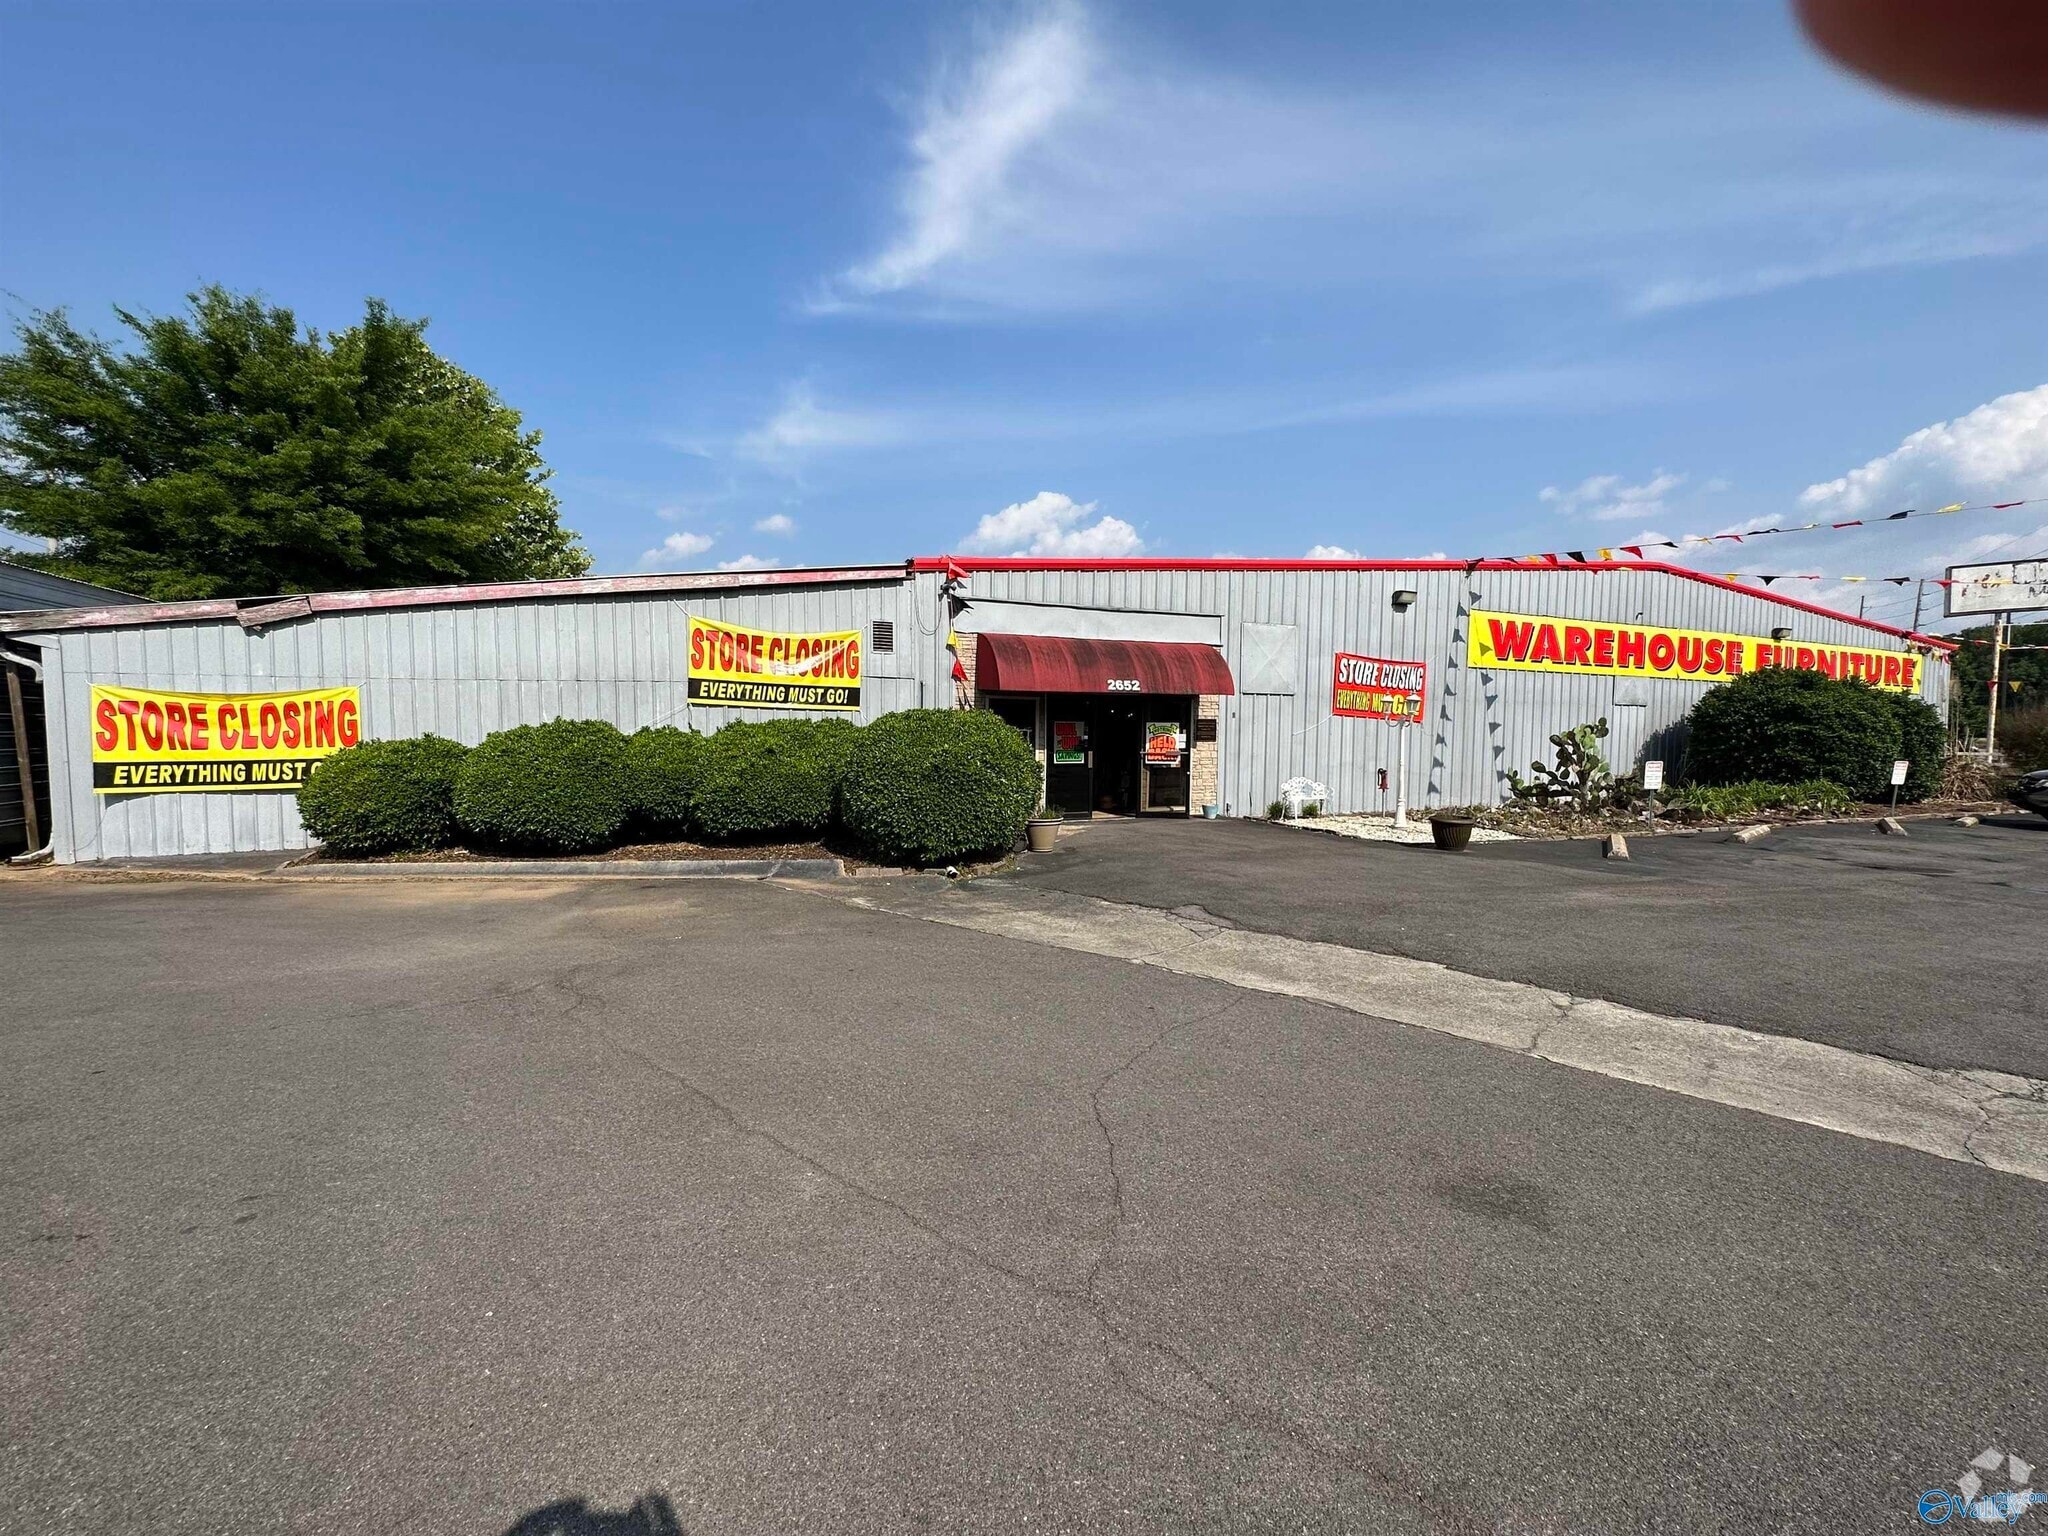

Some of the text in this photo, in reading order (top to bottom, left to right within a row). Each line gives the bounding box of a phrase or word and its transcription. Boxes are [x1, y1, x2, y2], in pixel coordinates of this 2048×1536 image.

[691, 627, 859, 679] STORE CLOSING
[1488, 619, 1918, 687] WAREHOUSE FURNITURE
[1107, 679, 1141, 691] 2652
[1339, 658, 1424, 691] STORE CLOSING
[699, 681, 849, 704] EVERYTHING MUST GO!
[1336, 689, 1370, 711] EVERYTHING
[95, 698, 359, 752] STORE CLOSING
[113, 763, 246, 785] EVERYTHING
[252, 762, 305, 782] MUST
